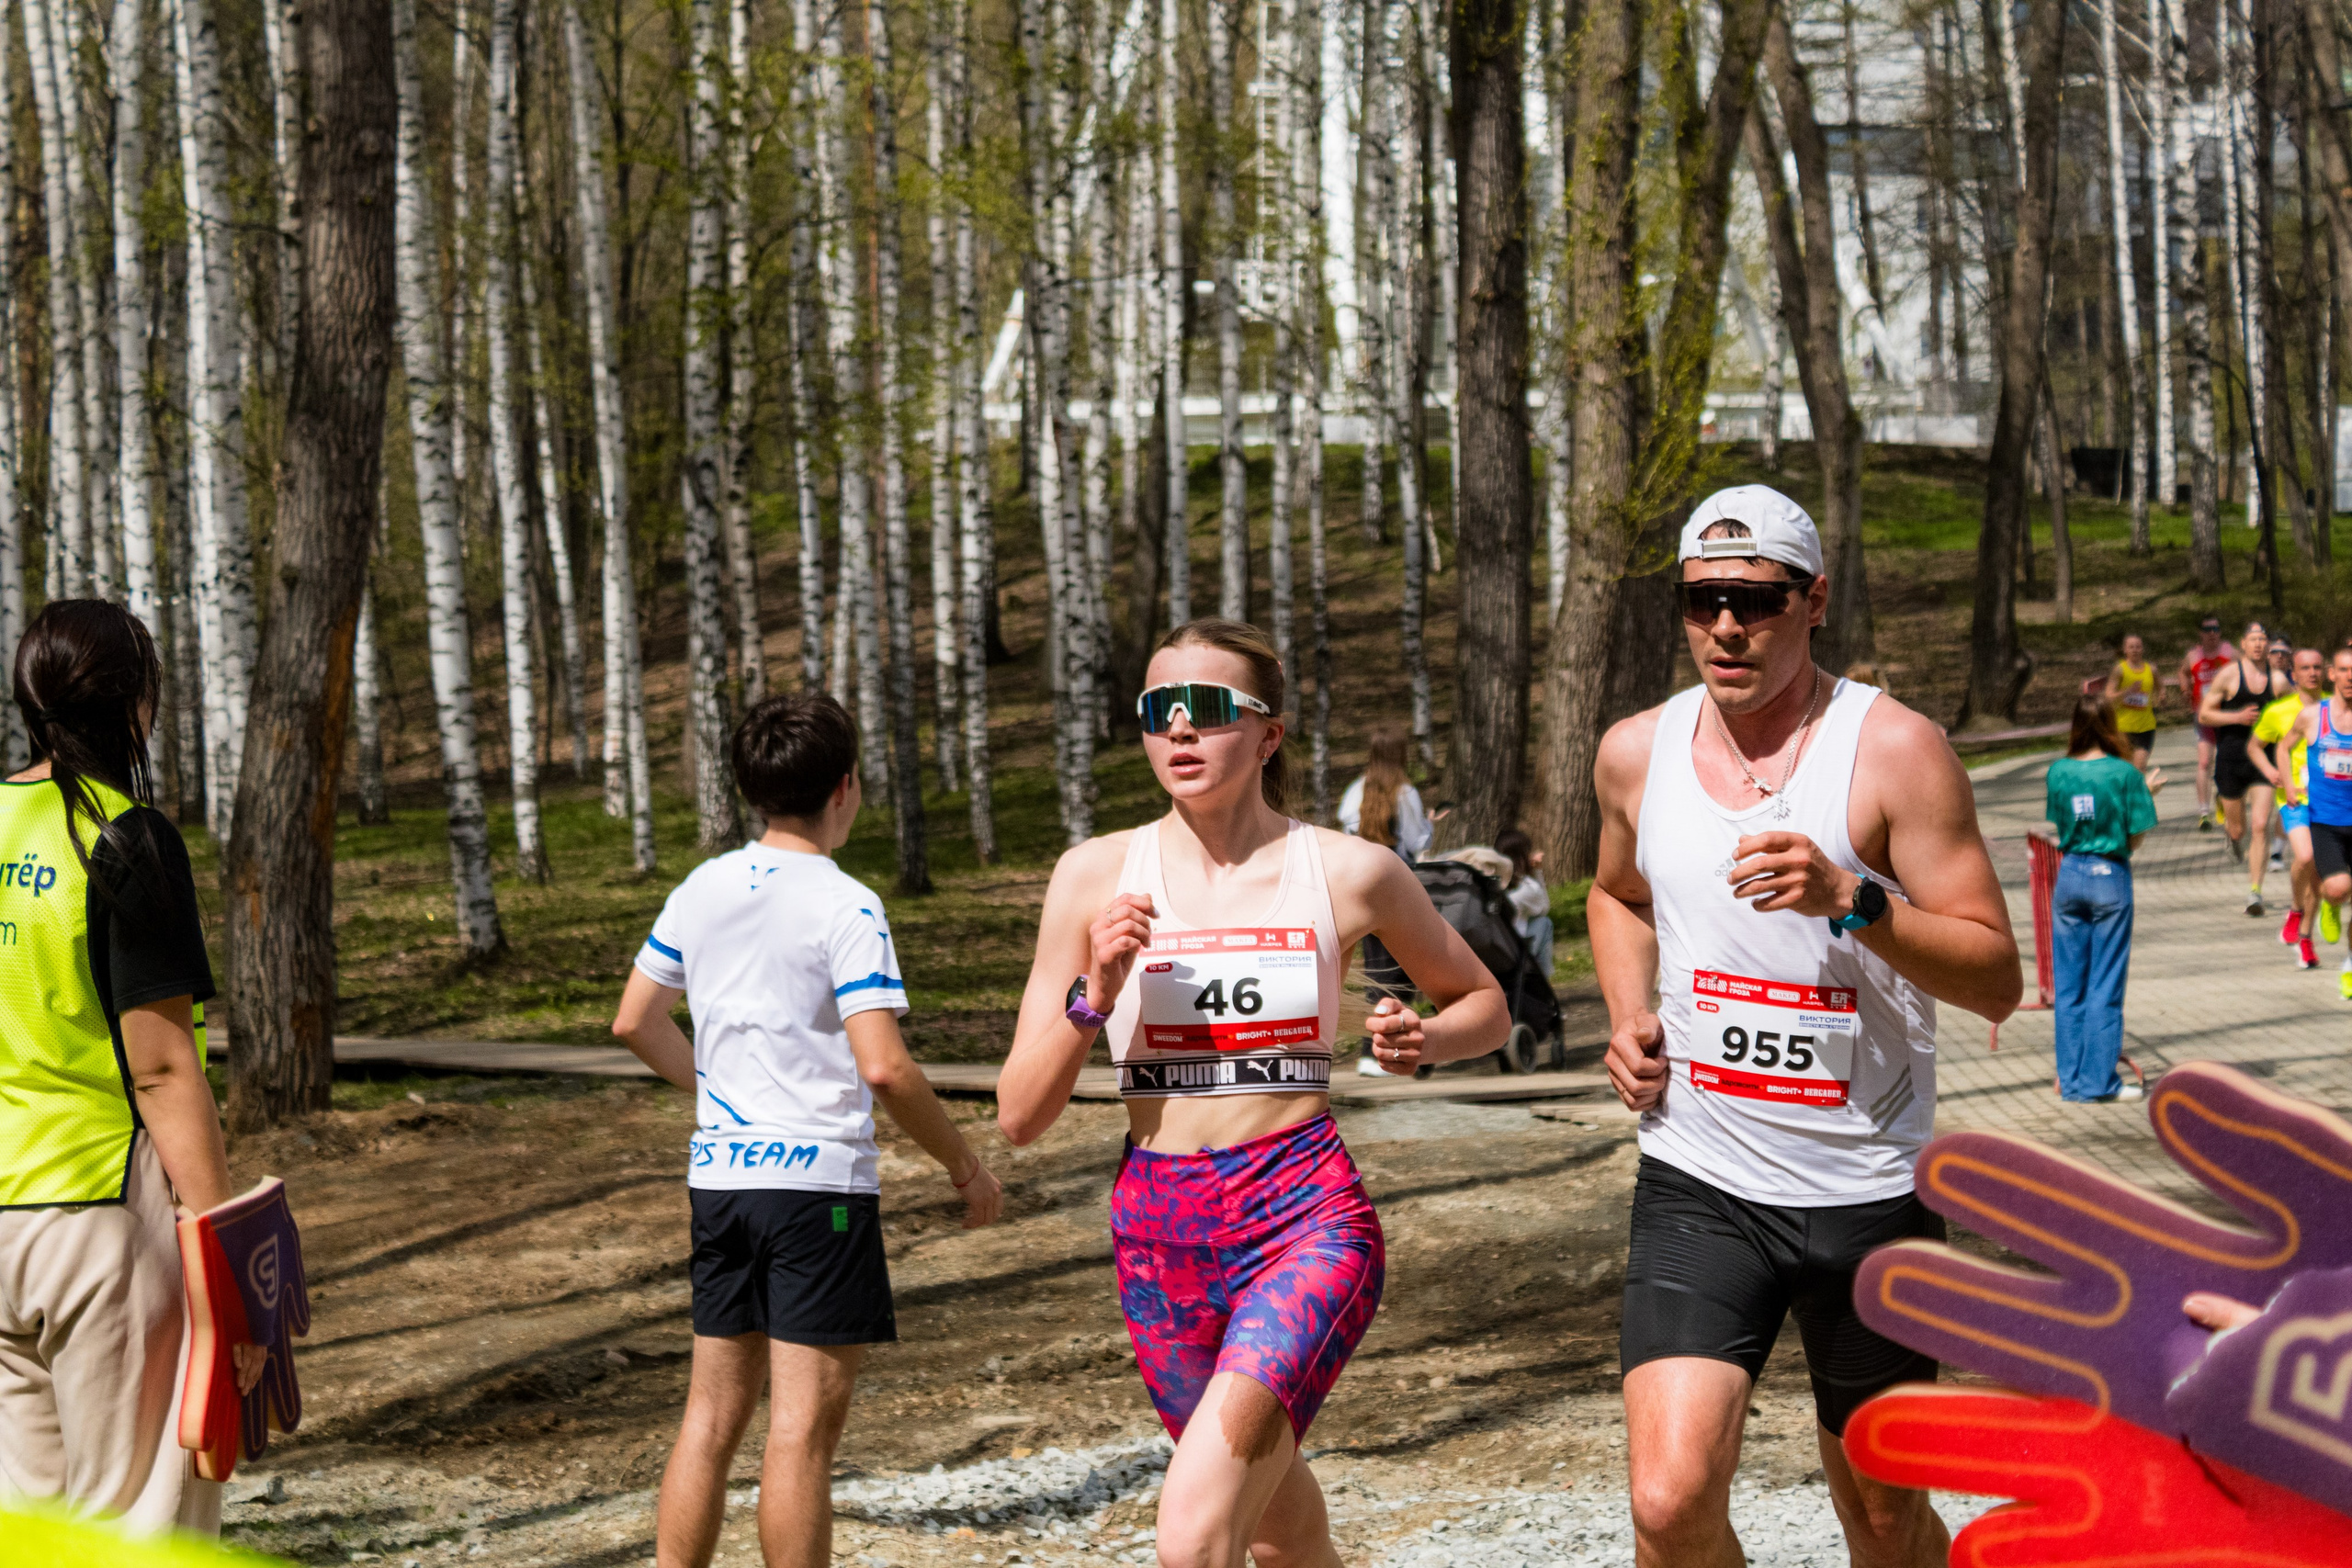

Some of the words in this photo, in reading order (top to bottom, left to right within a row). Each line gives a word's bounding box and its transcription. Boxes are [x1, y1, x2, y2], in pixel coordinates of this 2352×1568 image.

[2337, 762, 2352, 773] 51
[1181, 935, 1216, 943] МАЙСКАЯ
[1729, 981, 1762, 992] МАЙСКАЯ
[1193, 976, 1263, 1017] 46
[1729, 988, 1750, 997] ГРОЗА
[1799, 1014, 1851, 1024] ВИКТОРИЯ
[1273, 1026, 1313, 1037] BERGAUER
[1153, 1034, 1182, 1043] SWEEDOM
[1721, 1026, 1815, 1072] 955
[1165, 1061, 1237, 1088] PUMA
[1280, 1058, 1330, 1082] PUMA
[1804, 1088, 1841, 1098] BERGAUER
[729, 1141, 820, 1171] TEAM
